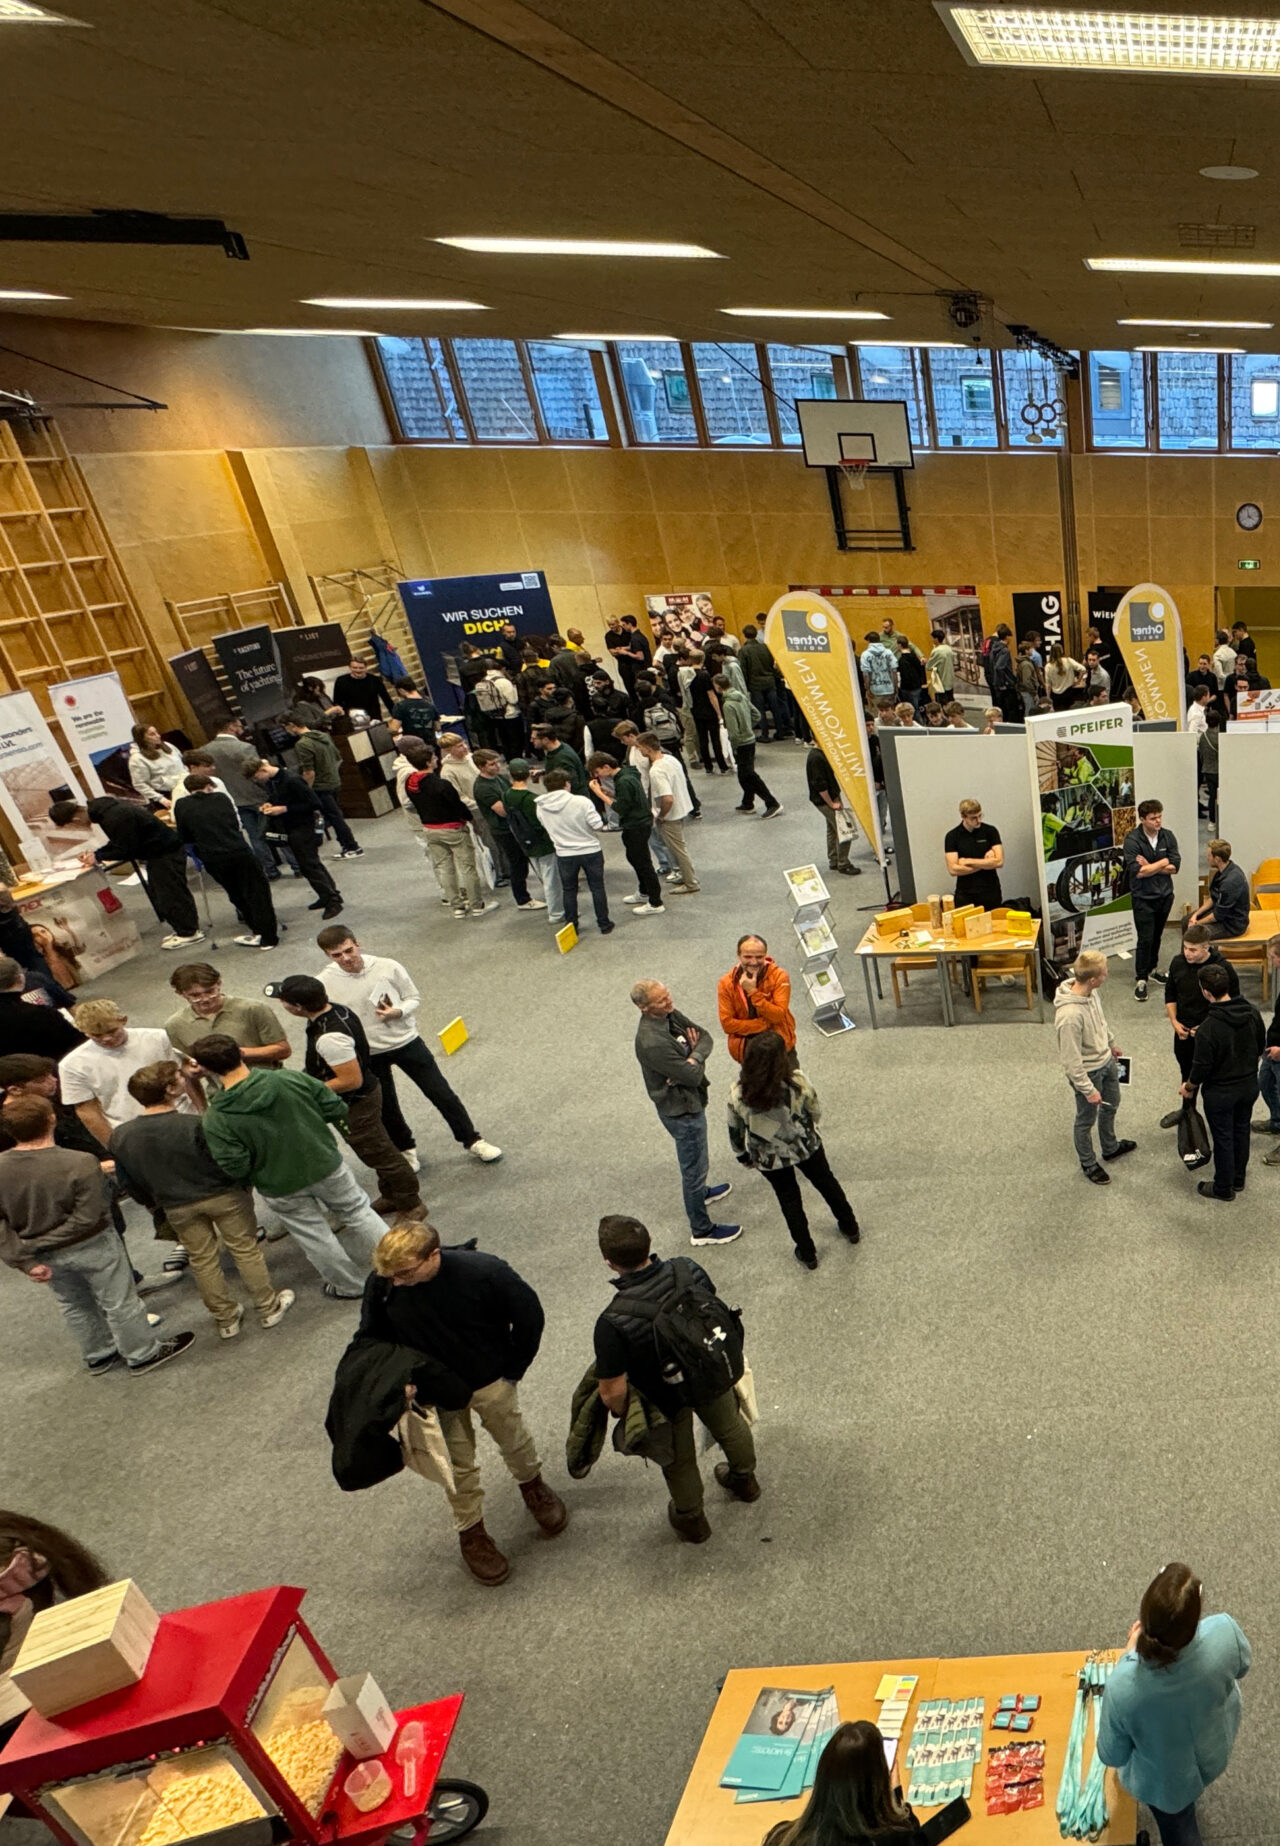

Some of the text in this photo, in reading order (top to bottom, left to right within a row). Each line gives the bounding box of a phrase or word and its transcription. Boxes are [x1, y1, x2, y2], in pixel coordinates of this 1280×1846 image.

[441, 605, 523, 622] WIR SUCHEN
[1041, 594, 1061, 660] HAG
[236, 663, 277, 680] The future
[240, 675, 283, 693] of yachting
[1070, 717, 1124, 736] PFEIFER
